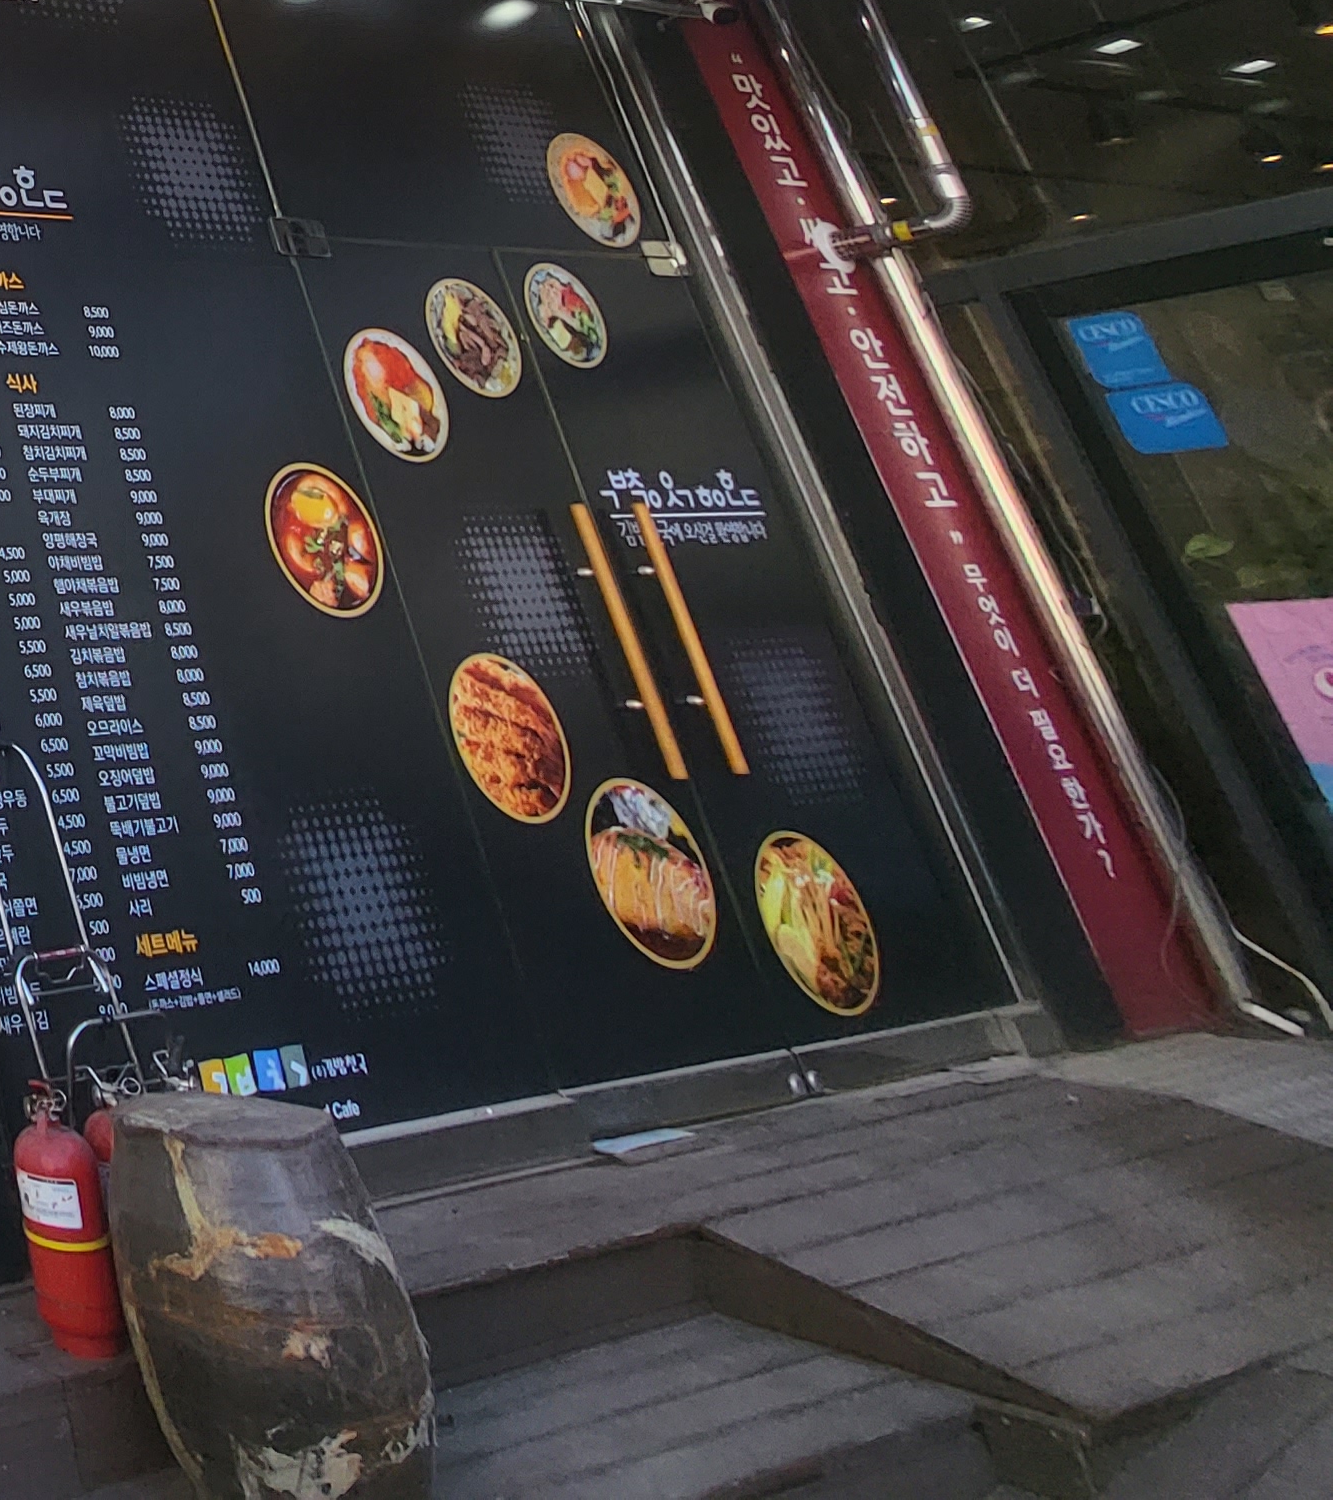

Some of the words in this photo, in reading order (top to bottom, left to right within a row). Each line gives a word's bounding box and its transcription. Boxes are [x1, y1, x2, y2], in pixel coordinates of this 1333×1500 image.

[83, 306, 109, 318] 8,500
[88, 326, 114, 338] 9,000
[88, 345, 119, 358] 10,000
[6, 374, 38, 394] 식사
[109, 407, 135, 420] 8,000
[114, 428, 141, 441] 8,500
[120, 448, 146, 461] 8,500
[125, 470, 151, 482] 8,500
[130, 491, 157, 504] 9,000
[136, 512, 163, 525] 9,000
[141, 534, 169, 547] 9,000
[0, 547, 25, 560] 4,500
[147, 556, 174, 569] 7,500
[4, 570, 30, 584] 5,000
[153, 578, 180, 591] 7,500
[9, 593, 35, 607] 5,000
[159, 600, 186, 614] 8,000
[14, 617, 41, 630] 5,000
[165, 623, 192, 636] 8,500
[19, 640, 46, 654] 5,500
[171, 645, 198, 660] 8,000
[24, 664, 52, 678] 6,500
[176, 668, 204, 683] 8,000
[30, 688, 57, 703] 5,500
[182, 691, 211, 706] 8,500
[35, 713, 62, 727] 6,000
[188, 715, 217, 730] 8,500
[41, 738, 68, 752] 6,500
[194, 739, 223, 754] 9,000
[46, 763, 74, 778] 5,500
[201, 763, 229, 779] 9,000
[52, 788, 80, 803] 6,500
[207, 788, 235, 804] 9,000
[58, 814, 86, 830] 4,500
[213, 812, 241, 829] 9,000
[64, 840, 91, 856] 4,500
[220, 837, 248, 854] 7,000
[226, 862, 254, 880] 7,000
[129, 898, 153, 918] 사리
[241, 888, 262, 904] 500
[89, 920, 109, 935] 500
[136, 929, 198, 958] 세트메뉴
[248, 959, 280, 976] 14,000
